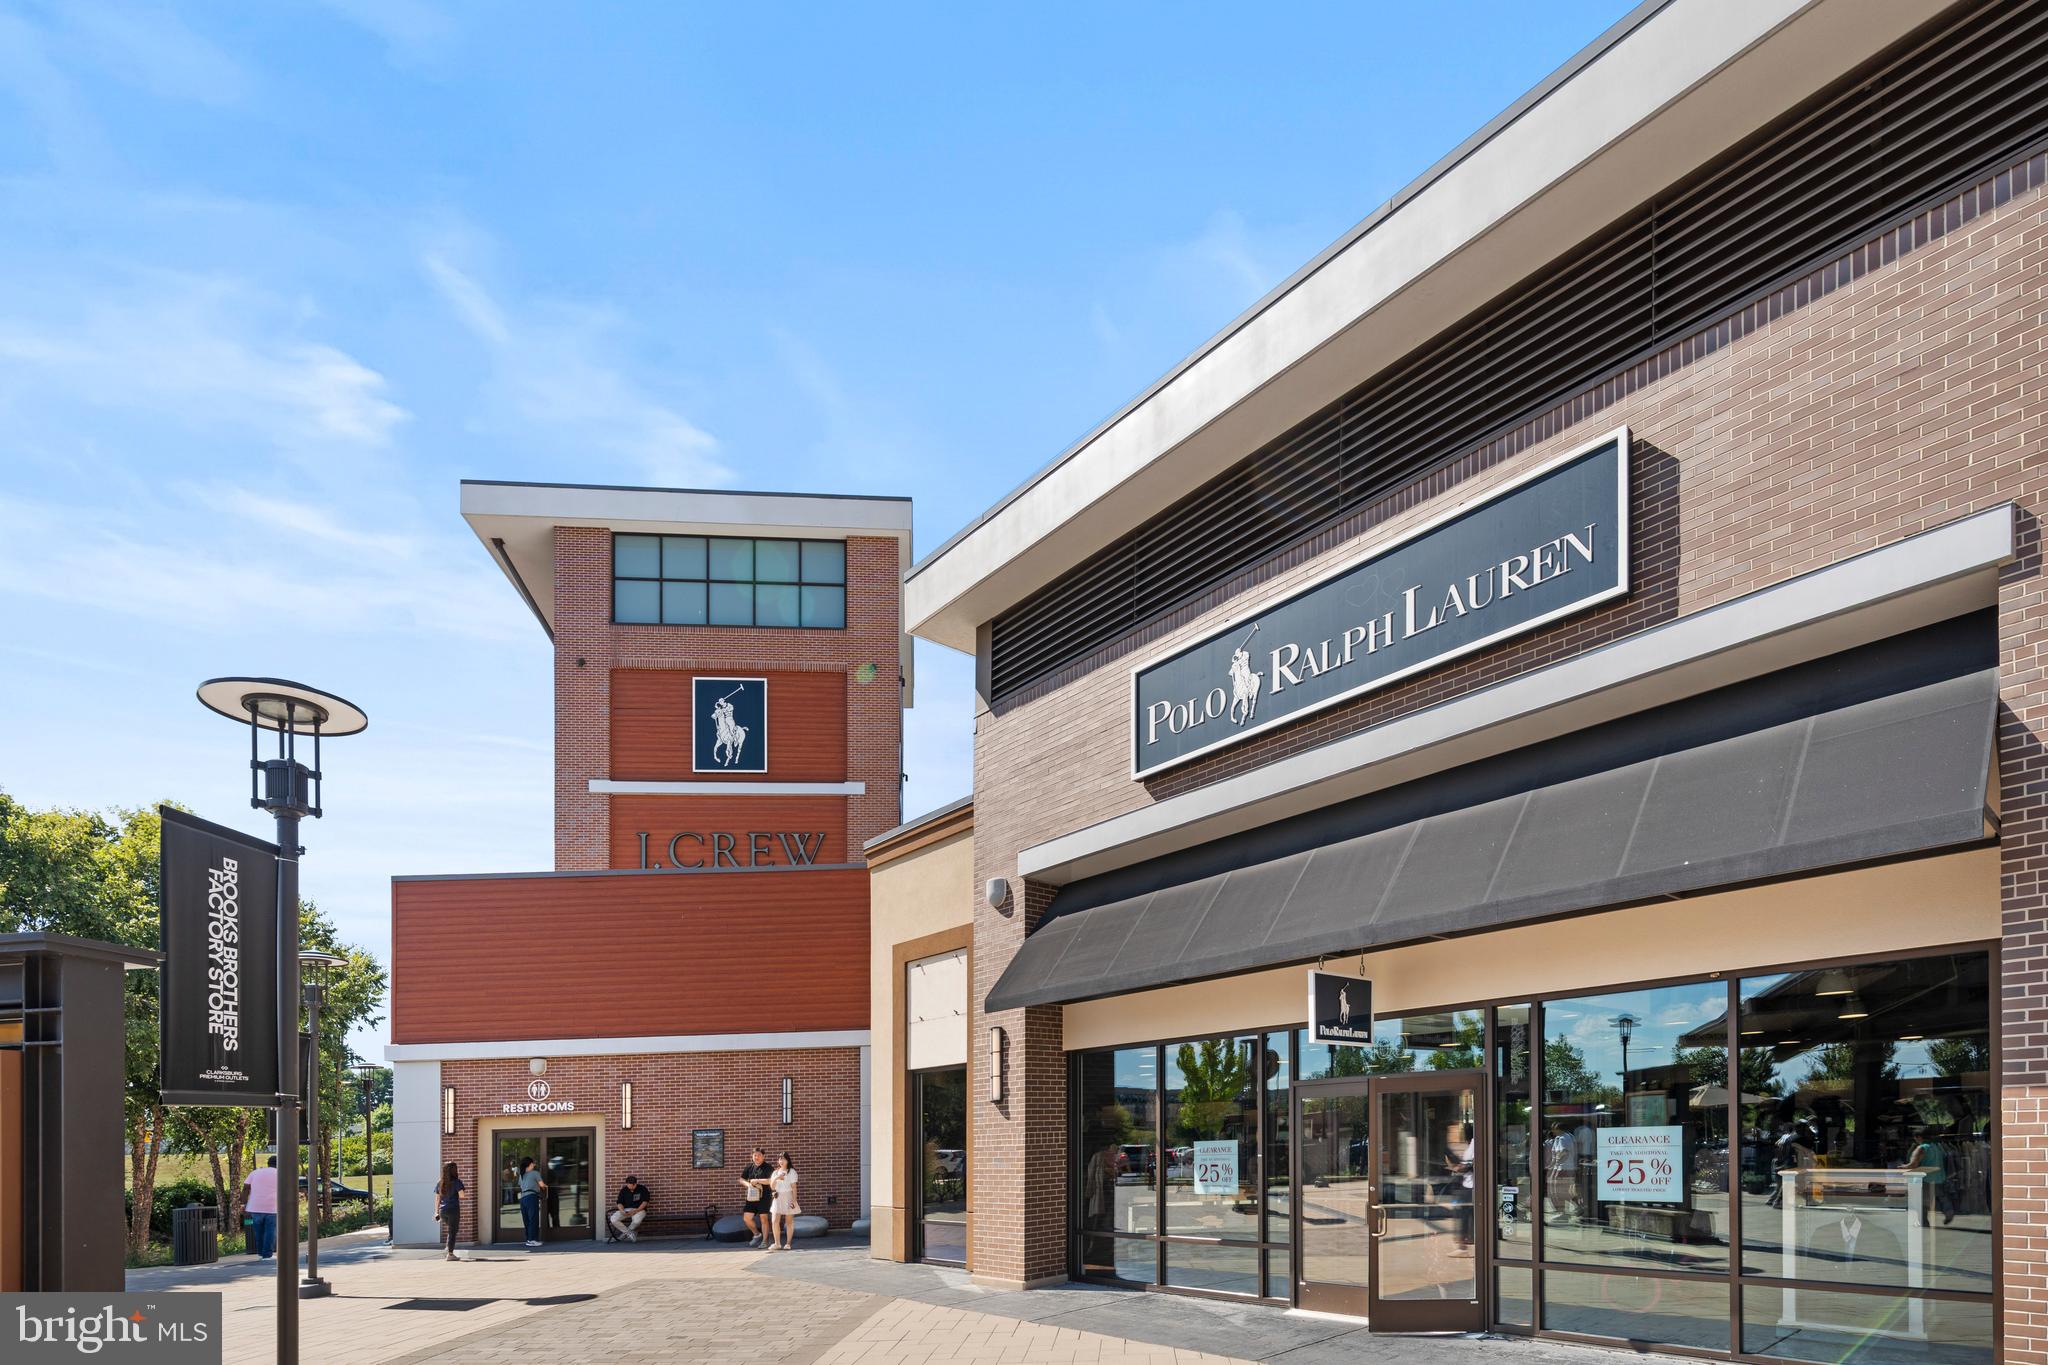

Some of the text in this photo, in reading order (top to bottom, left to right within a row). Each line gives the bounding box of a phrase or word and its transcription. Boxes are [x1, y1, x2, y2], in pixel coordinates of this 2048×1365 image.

[1147, 523, 1598, 745] POLO RALPH LAUREN
[208, 867, 224, 1035] FACTORY STORE
[223, 856, 238, 1051] BROOKS BROTHERS
[503, 1102, 575, 1113] RESTROOMS
[1608, 1135, 1671, 1145] CLEARANCE
[1651, 1177, 1672, 1185] OFF
